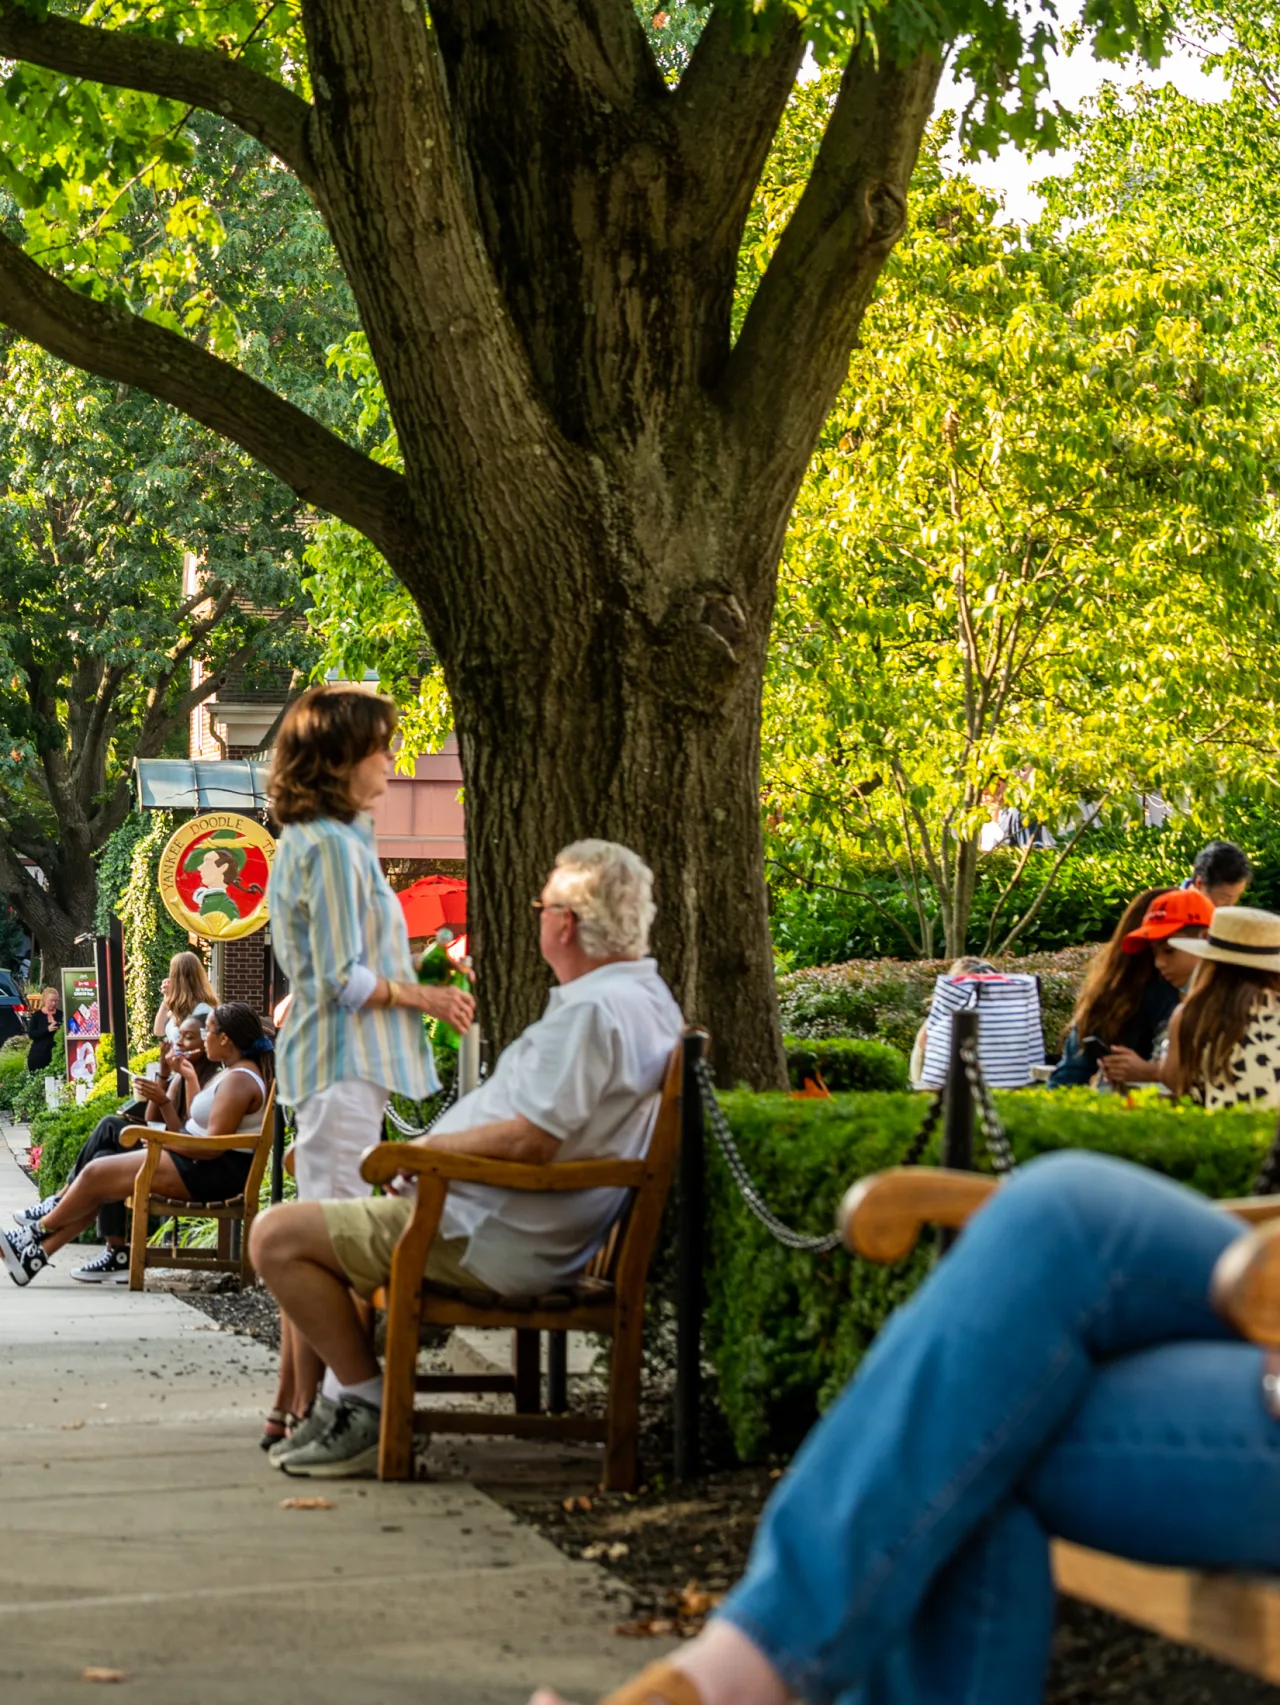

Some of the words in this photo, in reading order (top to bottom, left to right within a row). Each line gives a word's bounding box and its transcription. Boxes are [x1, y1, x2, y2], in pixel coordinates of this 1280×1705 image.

[163, 839, 185, 891] YANKEE
[189, 817, 244, 835] DOODLE
[262, 839, 276, 861] TA
